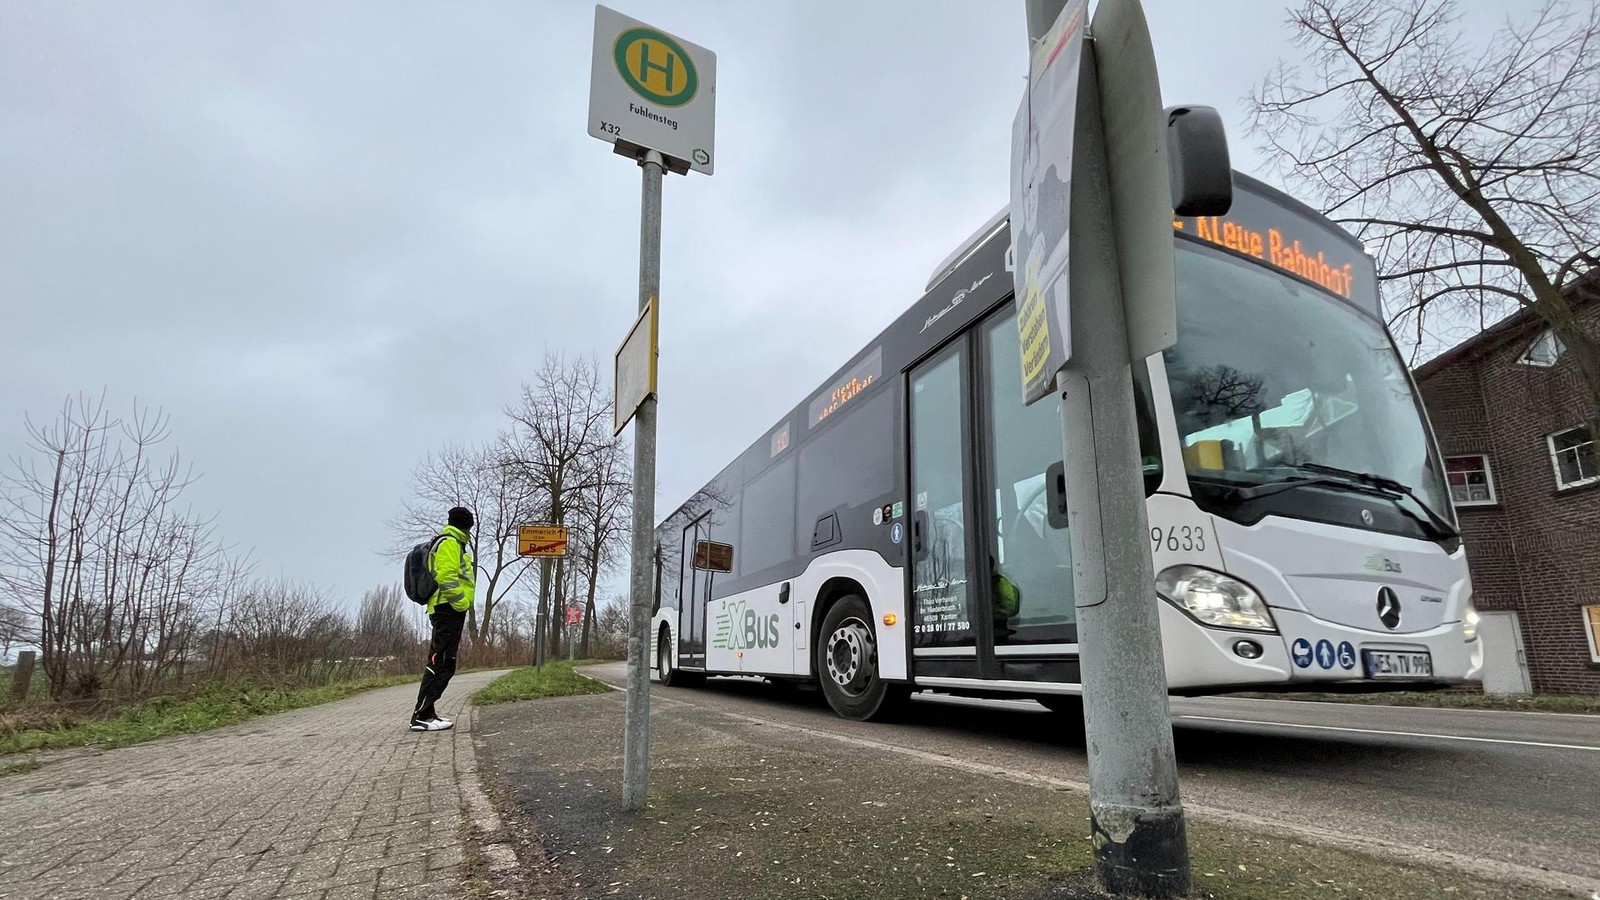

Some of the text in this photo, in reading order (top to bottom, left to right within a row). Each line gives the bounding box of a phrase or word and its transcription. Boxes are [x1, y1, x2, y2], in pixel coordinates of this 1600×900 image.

[639, 42, 674, 92] H
[600, 120, 621, 137] X32
[629, 102, 678, 131] Fuhlensteg
[1197, 215, 1353, 299] Kleve Bahnhof
[832, 377, 857, 402] Kleve
[841, 374, 873, 405] Kalkar
[521, 527, 557, 535] Emmerich
[1150, 525, 1206, 552] 9633
[529, 543, 556, 553] Rees
[947, 622, 956, 631] 77
